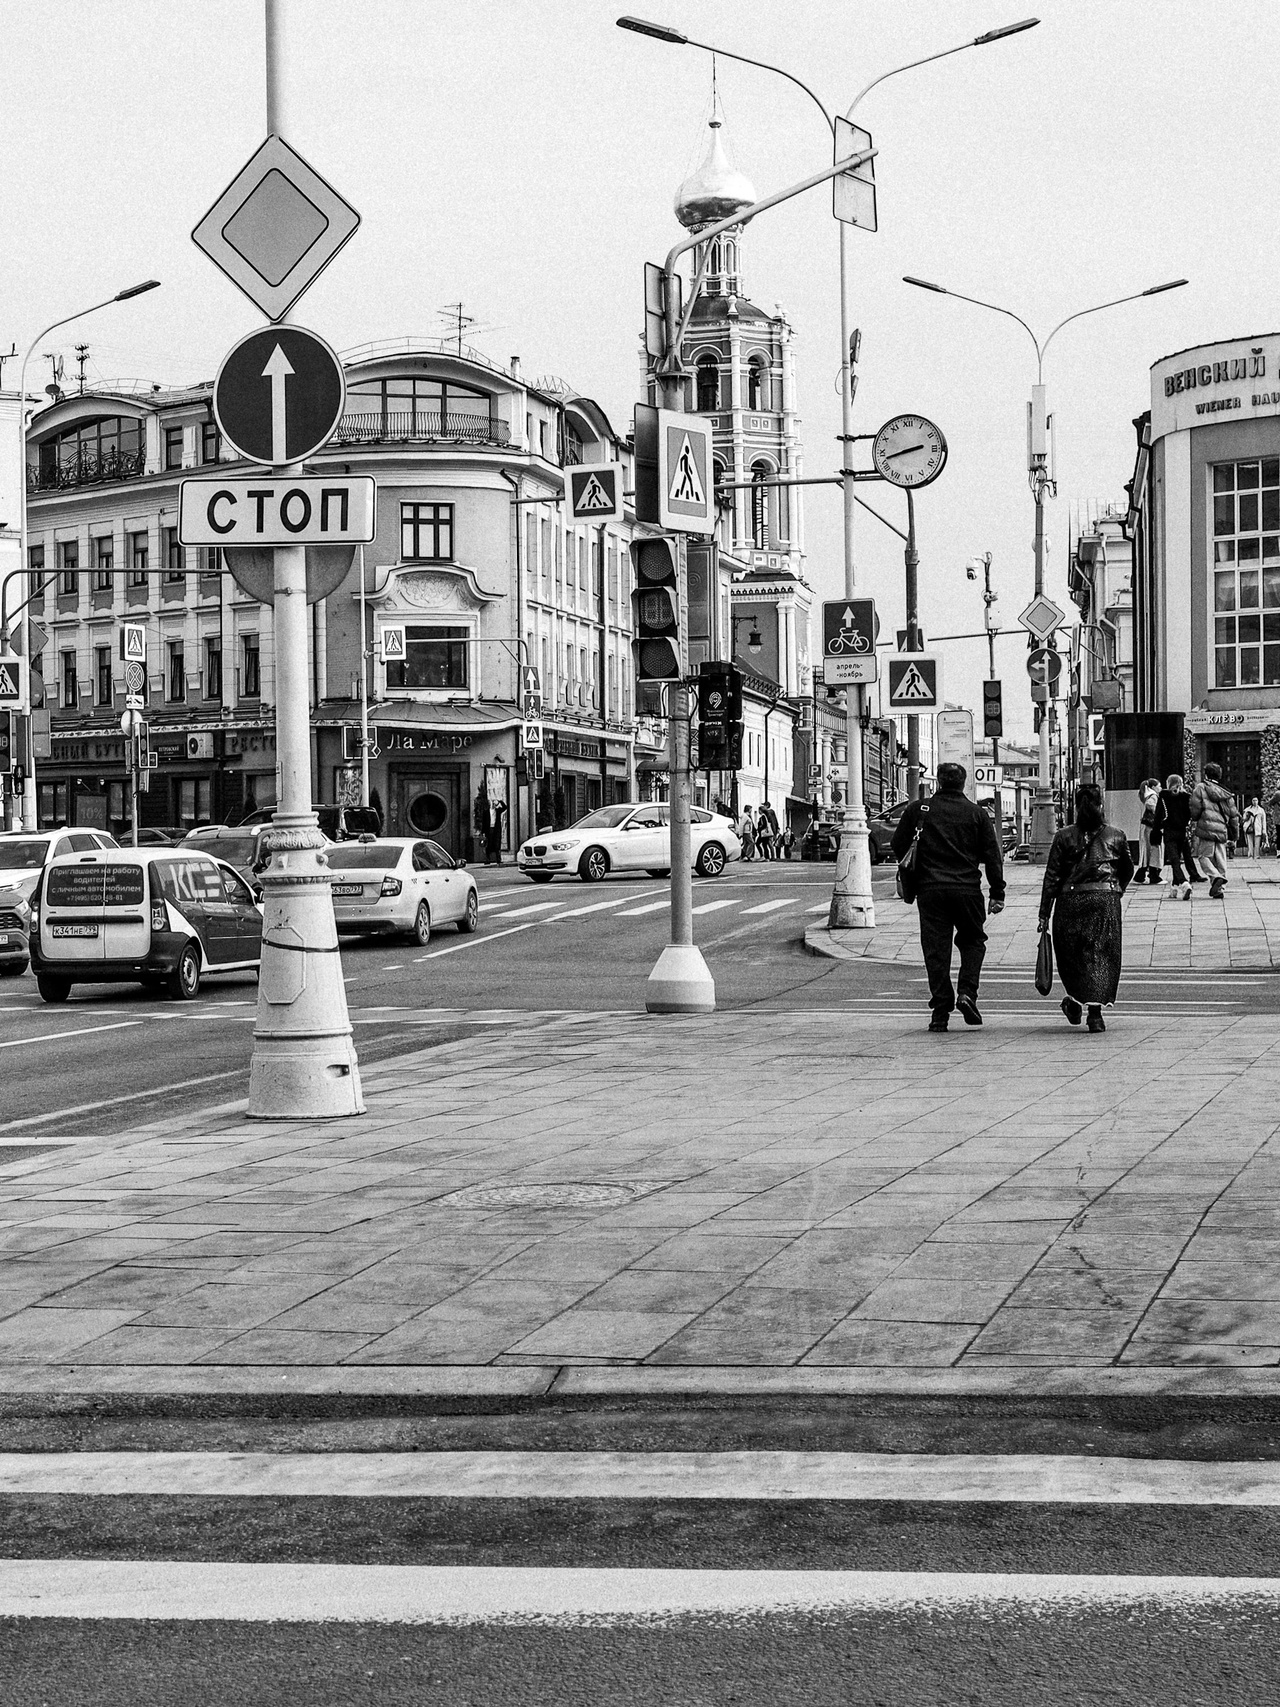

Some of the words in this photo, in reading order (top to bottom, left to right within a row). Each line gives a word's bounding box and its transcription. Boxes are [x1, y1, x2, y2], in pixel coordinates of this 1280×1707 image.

[1164, 348, 1266, 397] ВЕНСКИЙ
[1195, 397, 1241, 415] WIENER
[206, 488, 349, 535] СТОП
[1207, 714, 1245, 724] КЛЁВО
[386, 734, 415, 749] Ла
[420, 732, 473, 754] Маре
[975, 768, 996, 781] ОП
[52, 868, 100, 876] Приглашаем
[112, 867, 140, 875] работу
[73, 876, 116, 884] водителей
